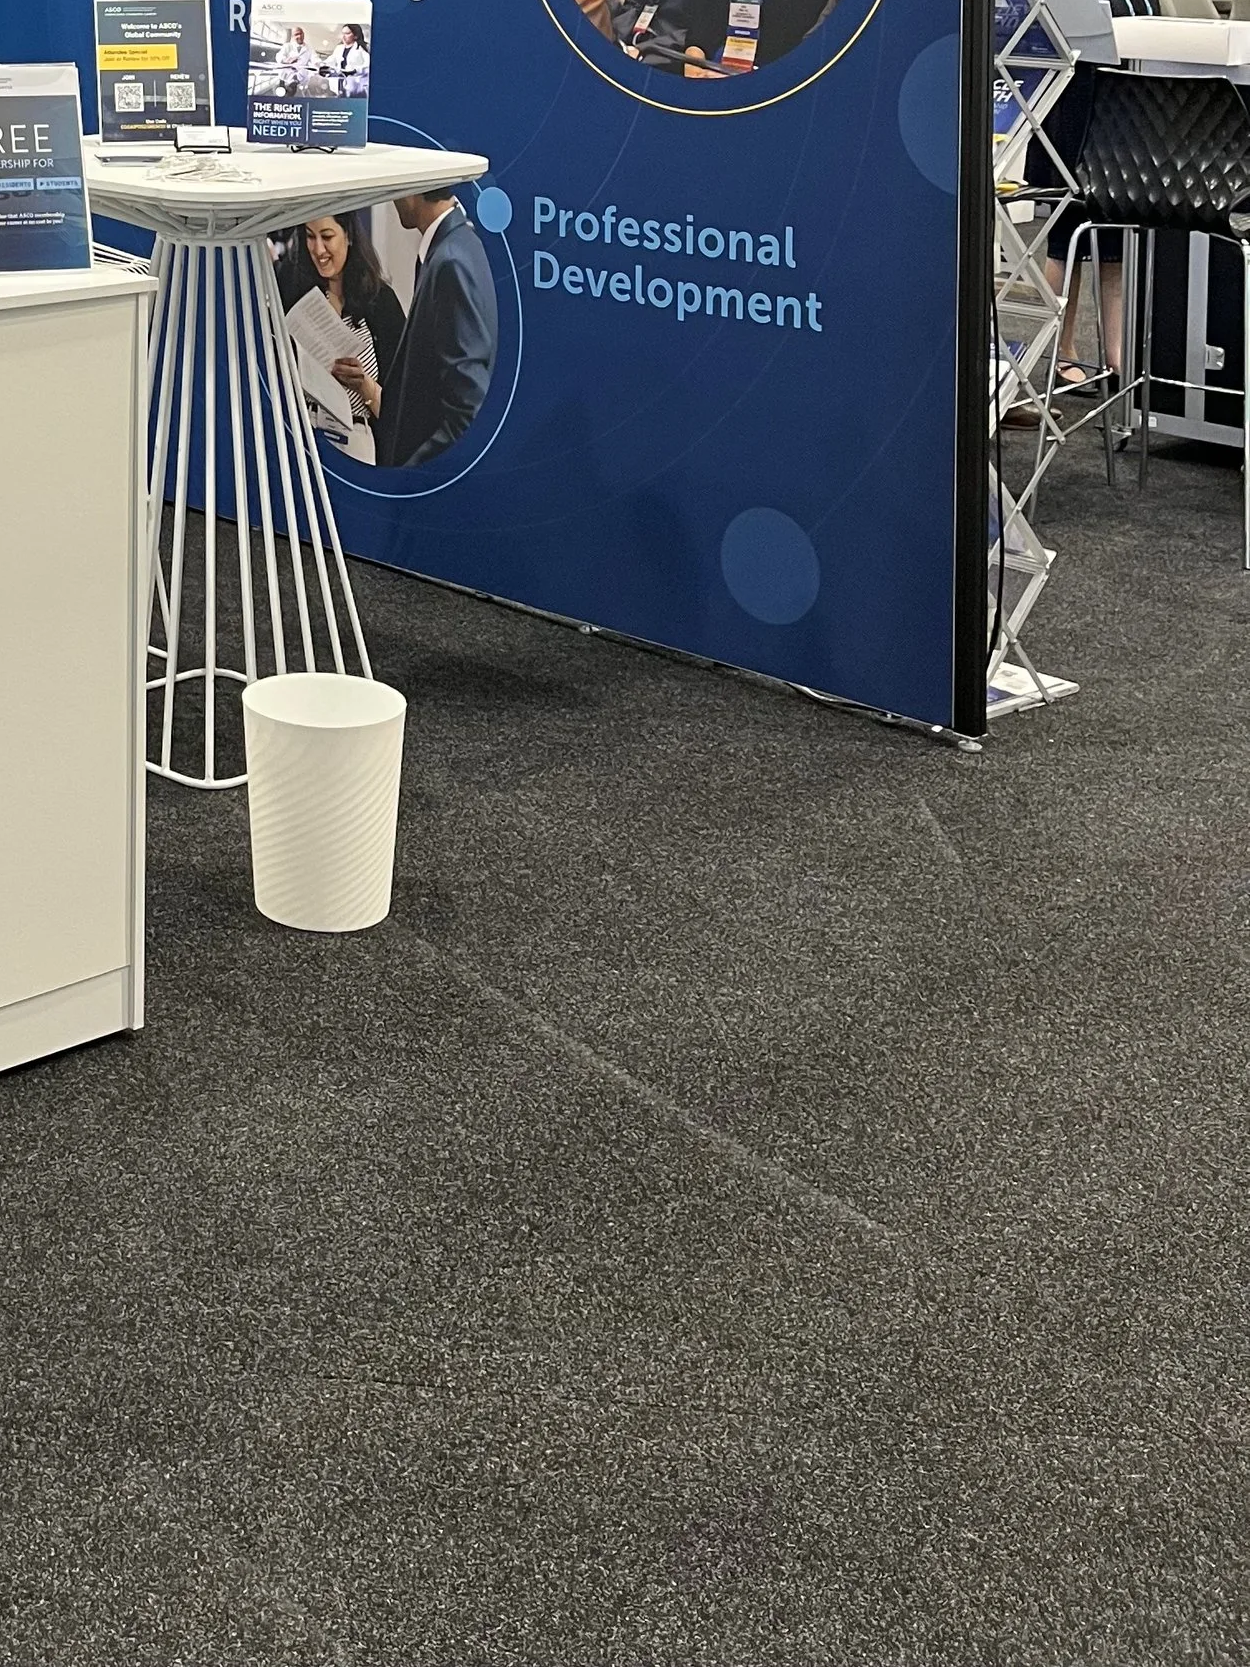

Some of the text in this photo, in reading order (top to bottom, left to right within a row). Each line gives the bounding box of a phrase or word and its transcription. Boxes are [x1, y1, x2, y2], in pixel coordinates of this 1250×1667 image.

[253, 102, 302, 113] THE RIGHT
[253, 124, 303, 138] NEED IT
[33, 158, 54, 168] FOR
[534, 196, 796, 268] Professional
[534, 250, 823, 332] Development
